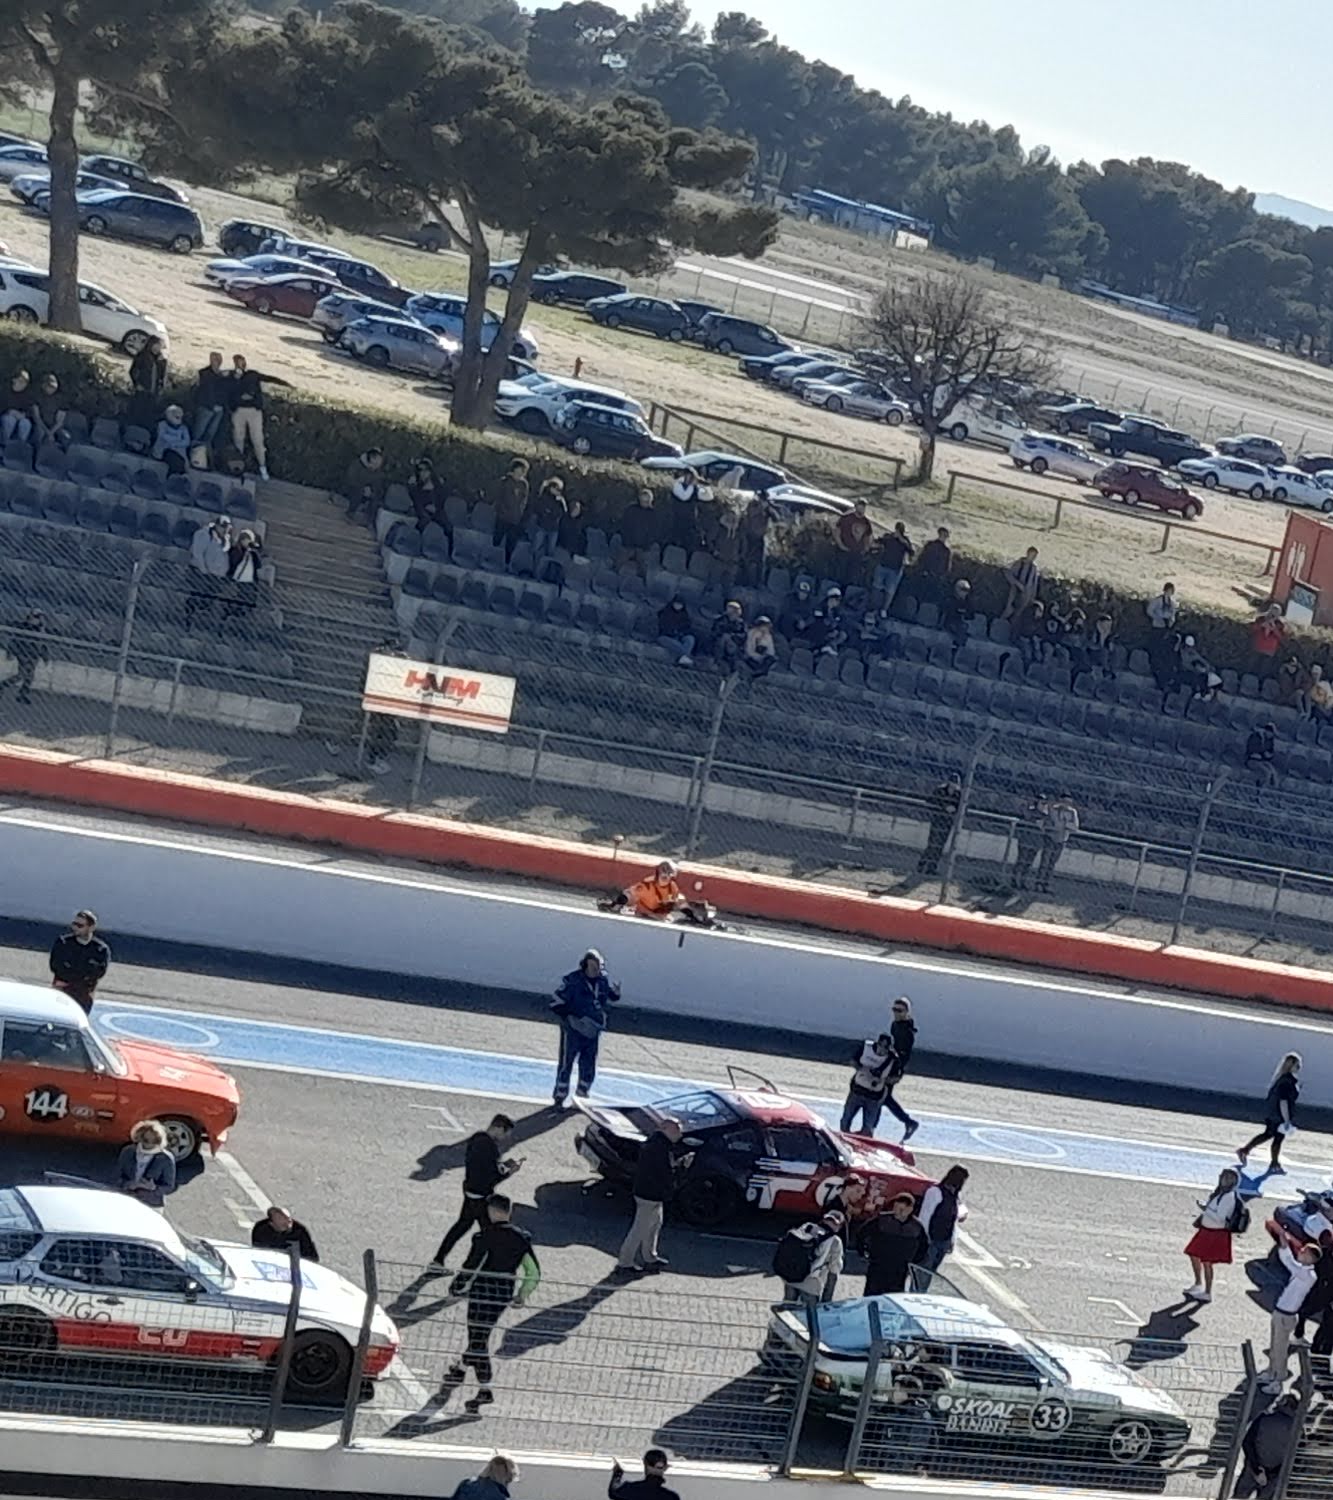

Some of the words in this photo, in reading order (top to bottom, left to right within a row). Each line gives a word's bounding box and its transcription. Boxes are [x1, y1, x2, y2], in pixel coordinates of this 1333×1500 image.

[25, 1090, 68, 1118] 144
[950, 1398, 1016, 1418] SKOAL
[1035, 1404, 1067, 1430] 33
